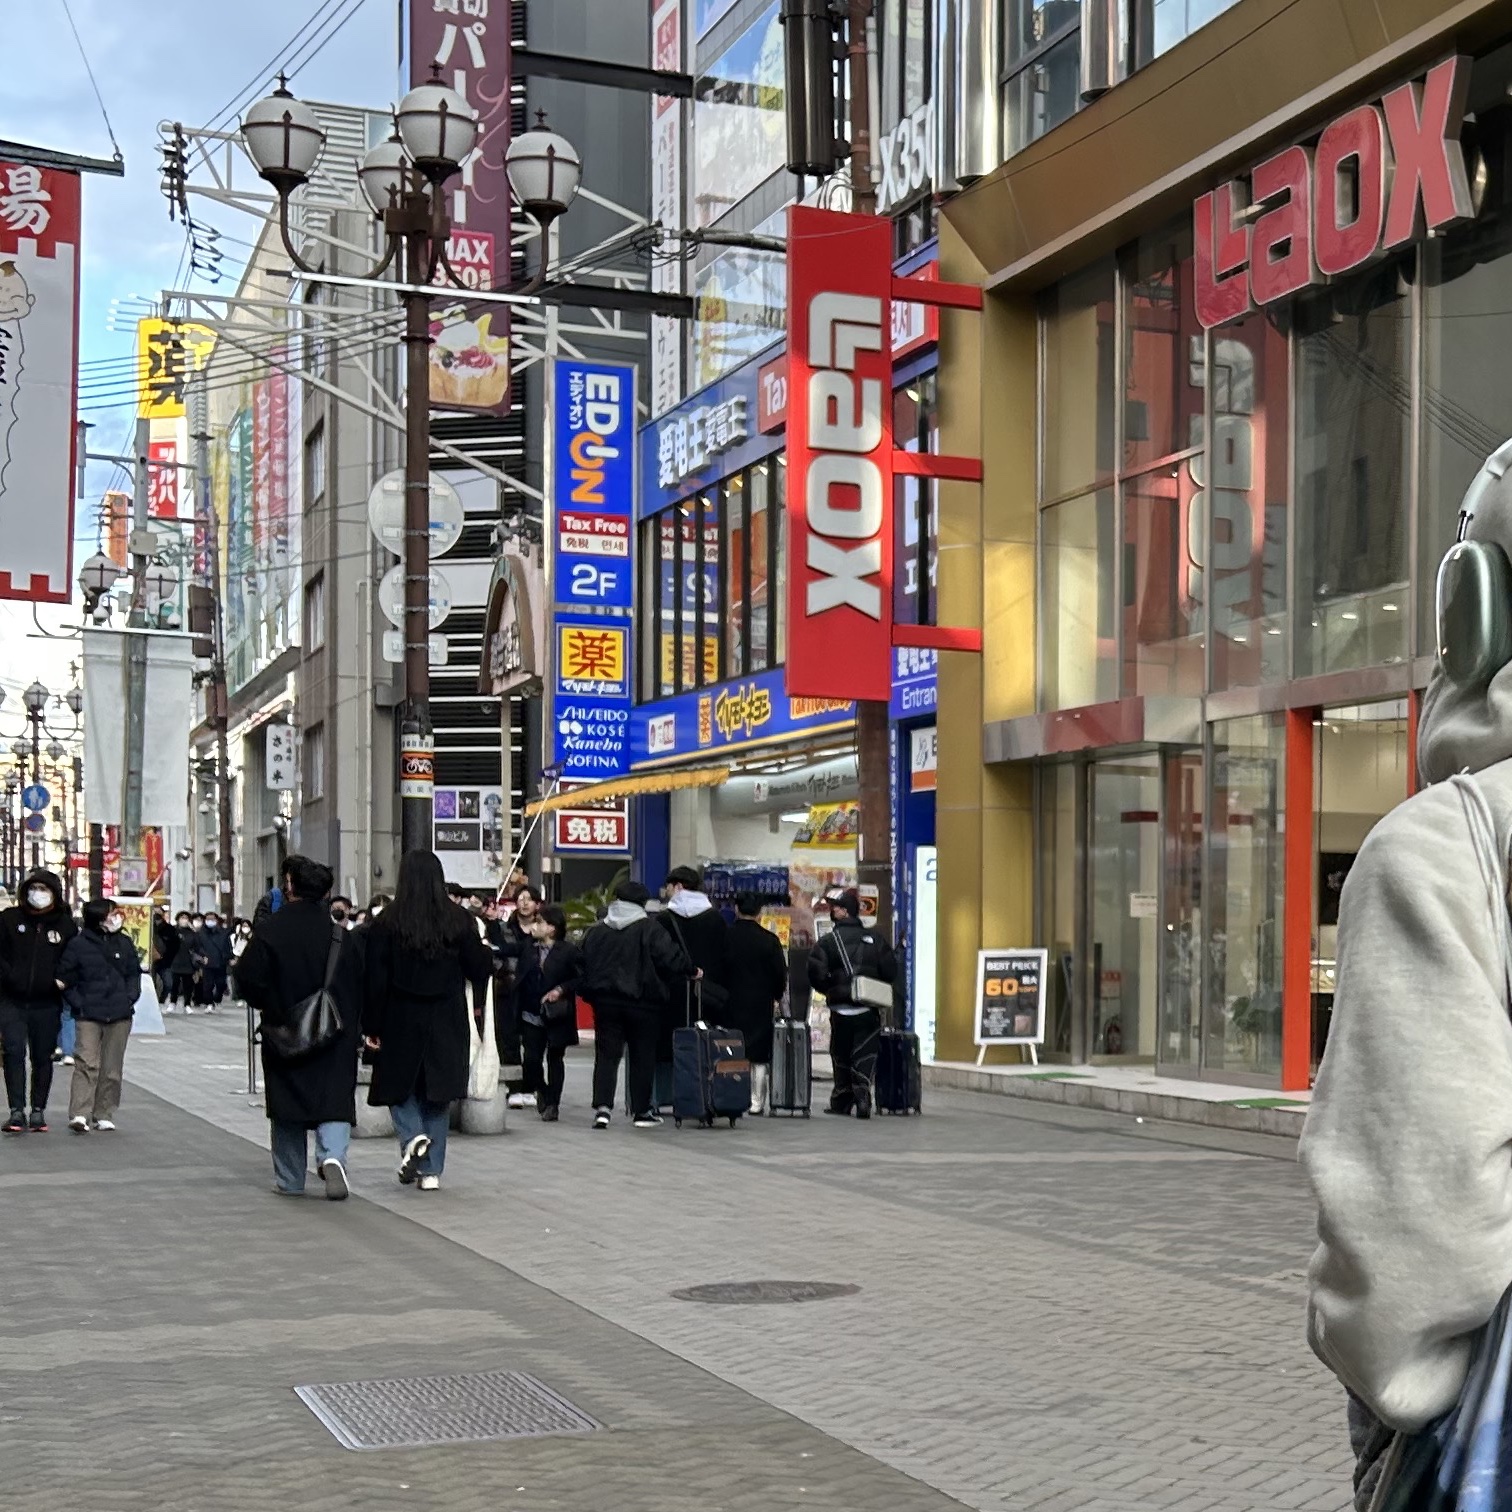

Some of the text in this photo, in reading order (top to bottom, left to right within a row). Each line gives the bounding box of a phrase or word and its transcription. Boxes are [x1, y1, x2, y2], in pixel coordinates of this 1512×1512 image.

[570, 373, 620, 504] EDION
[563, 516, 626, 534] Tax Free
[571, 564, 617, 596] 2F
[569, 631, 617, 678] 薬
[556, 706, 628, 721] SHISEIDO
[563, 736, 622, 751] Kanebo
[566, 754, 619, 769] SOFINA
[567, 817, 618, 843] 免税
